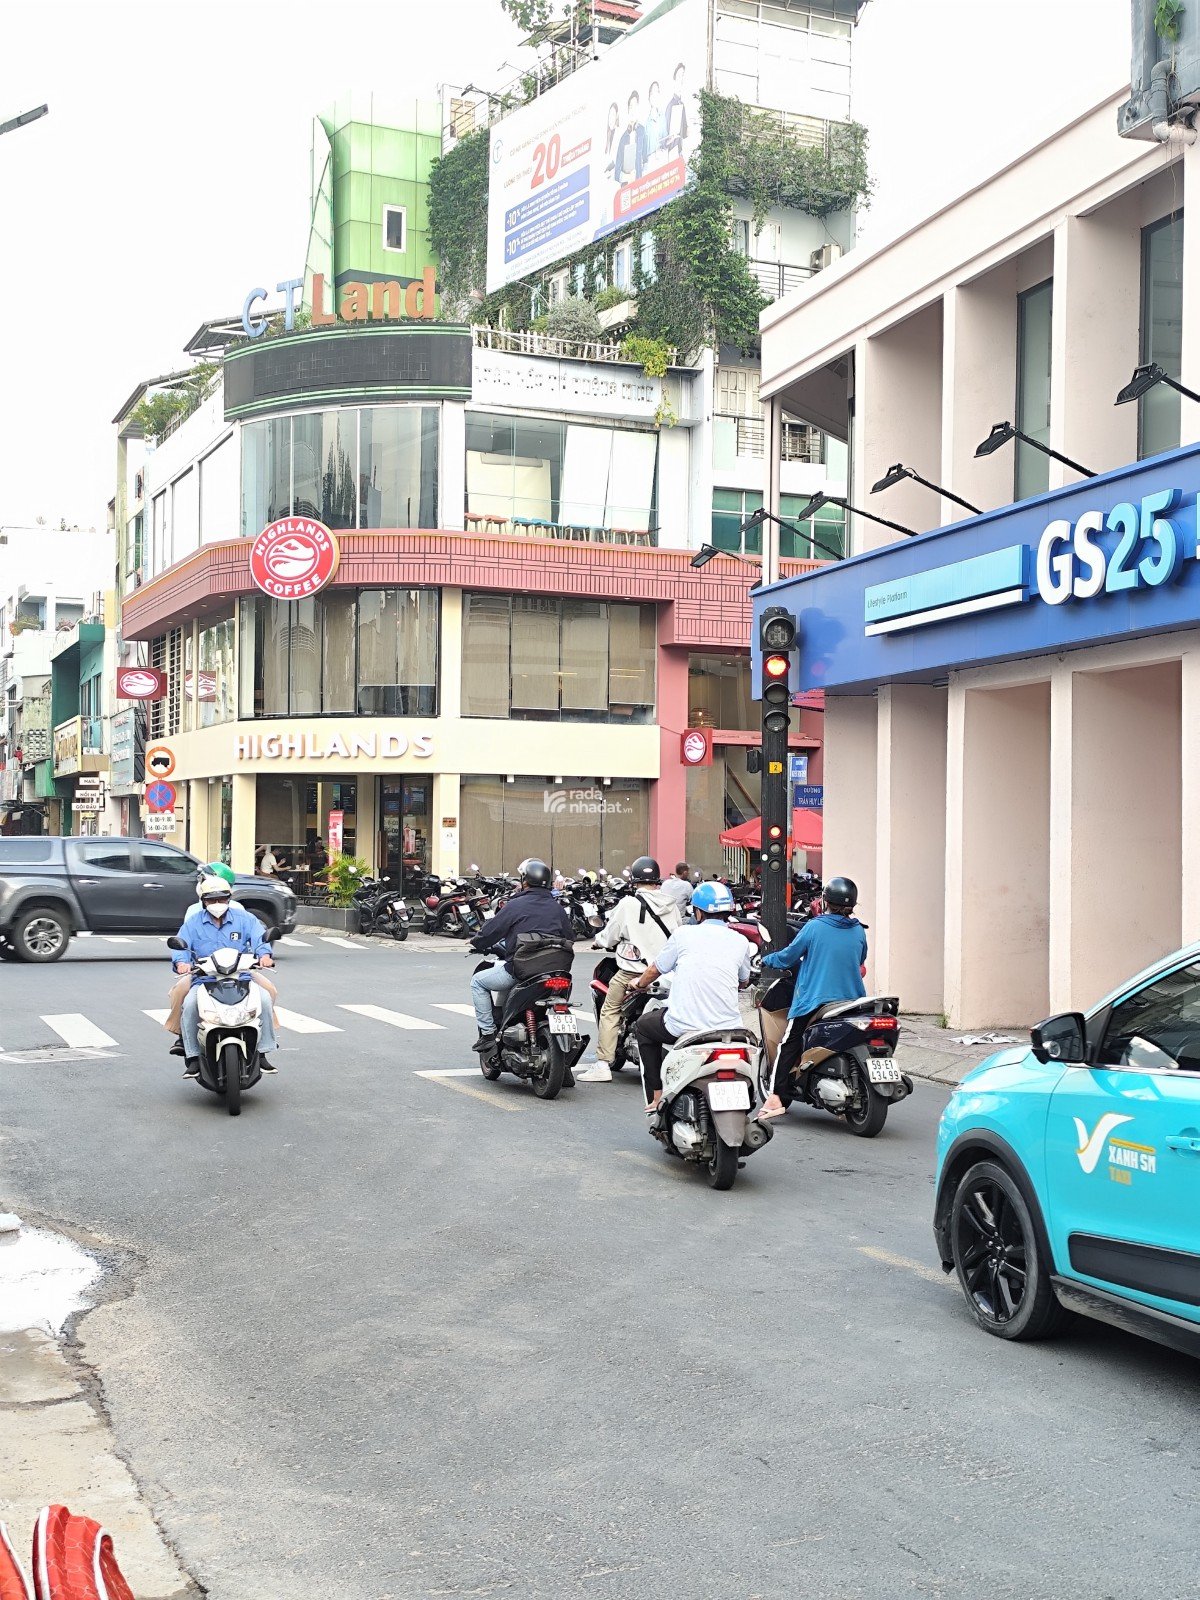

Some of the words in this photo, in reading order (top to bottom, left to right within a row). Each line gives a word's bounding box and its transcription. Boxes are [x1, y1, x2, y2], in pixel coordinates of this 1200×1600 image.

[530, 133, 561, 189] 20
[255, 521, 330, 557] HIGHLANDS
[1037, 489, 1182, 605] GS25
[264, 573, 322, 596] COFFEE
[234, 732, 435, 759] HIGHLANDS
[872, 1060, 893, 1070] 59-E1
[1108, 1145, 1139, 1170] XANH
[1140, 1153, 1156, 1174] SM
